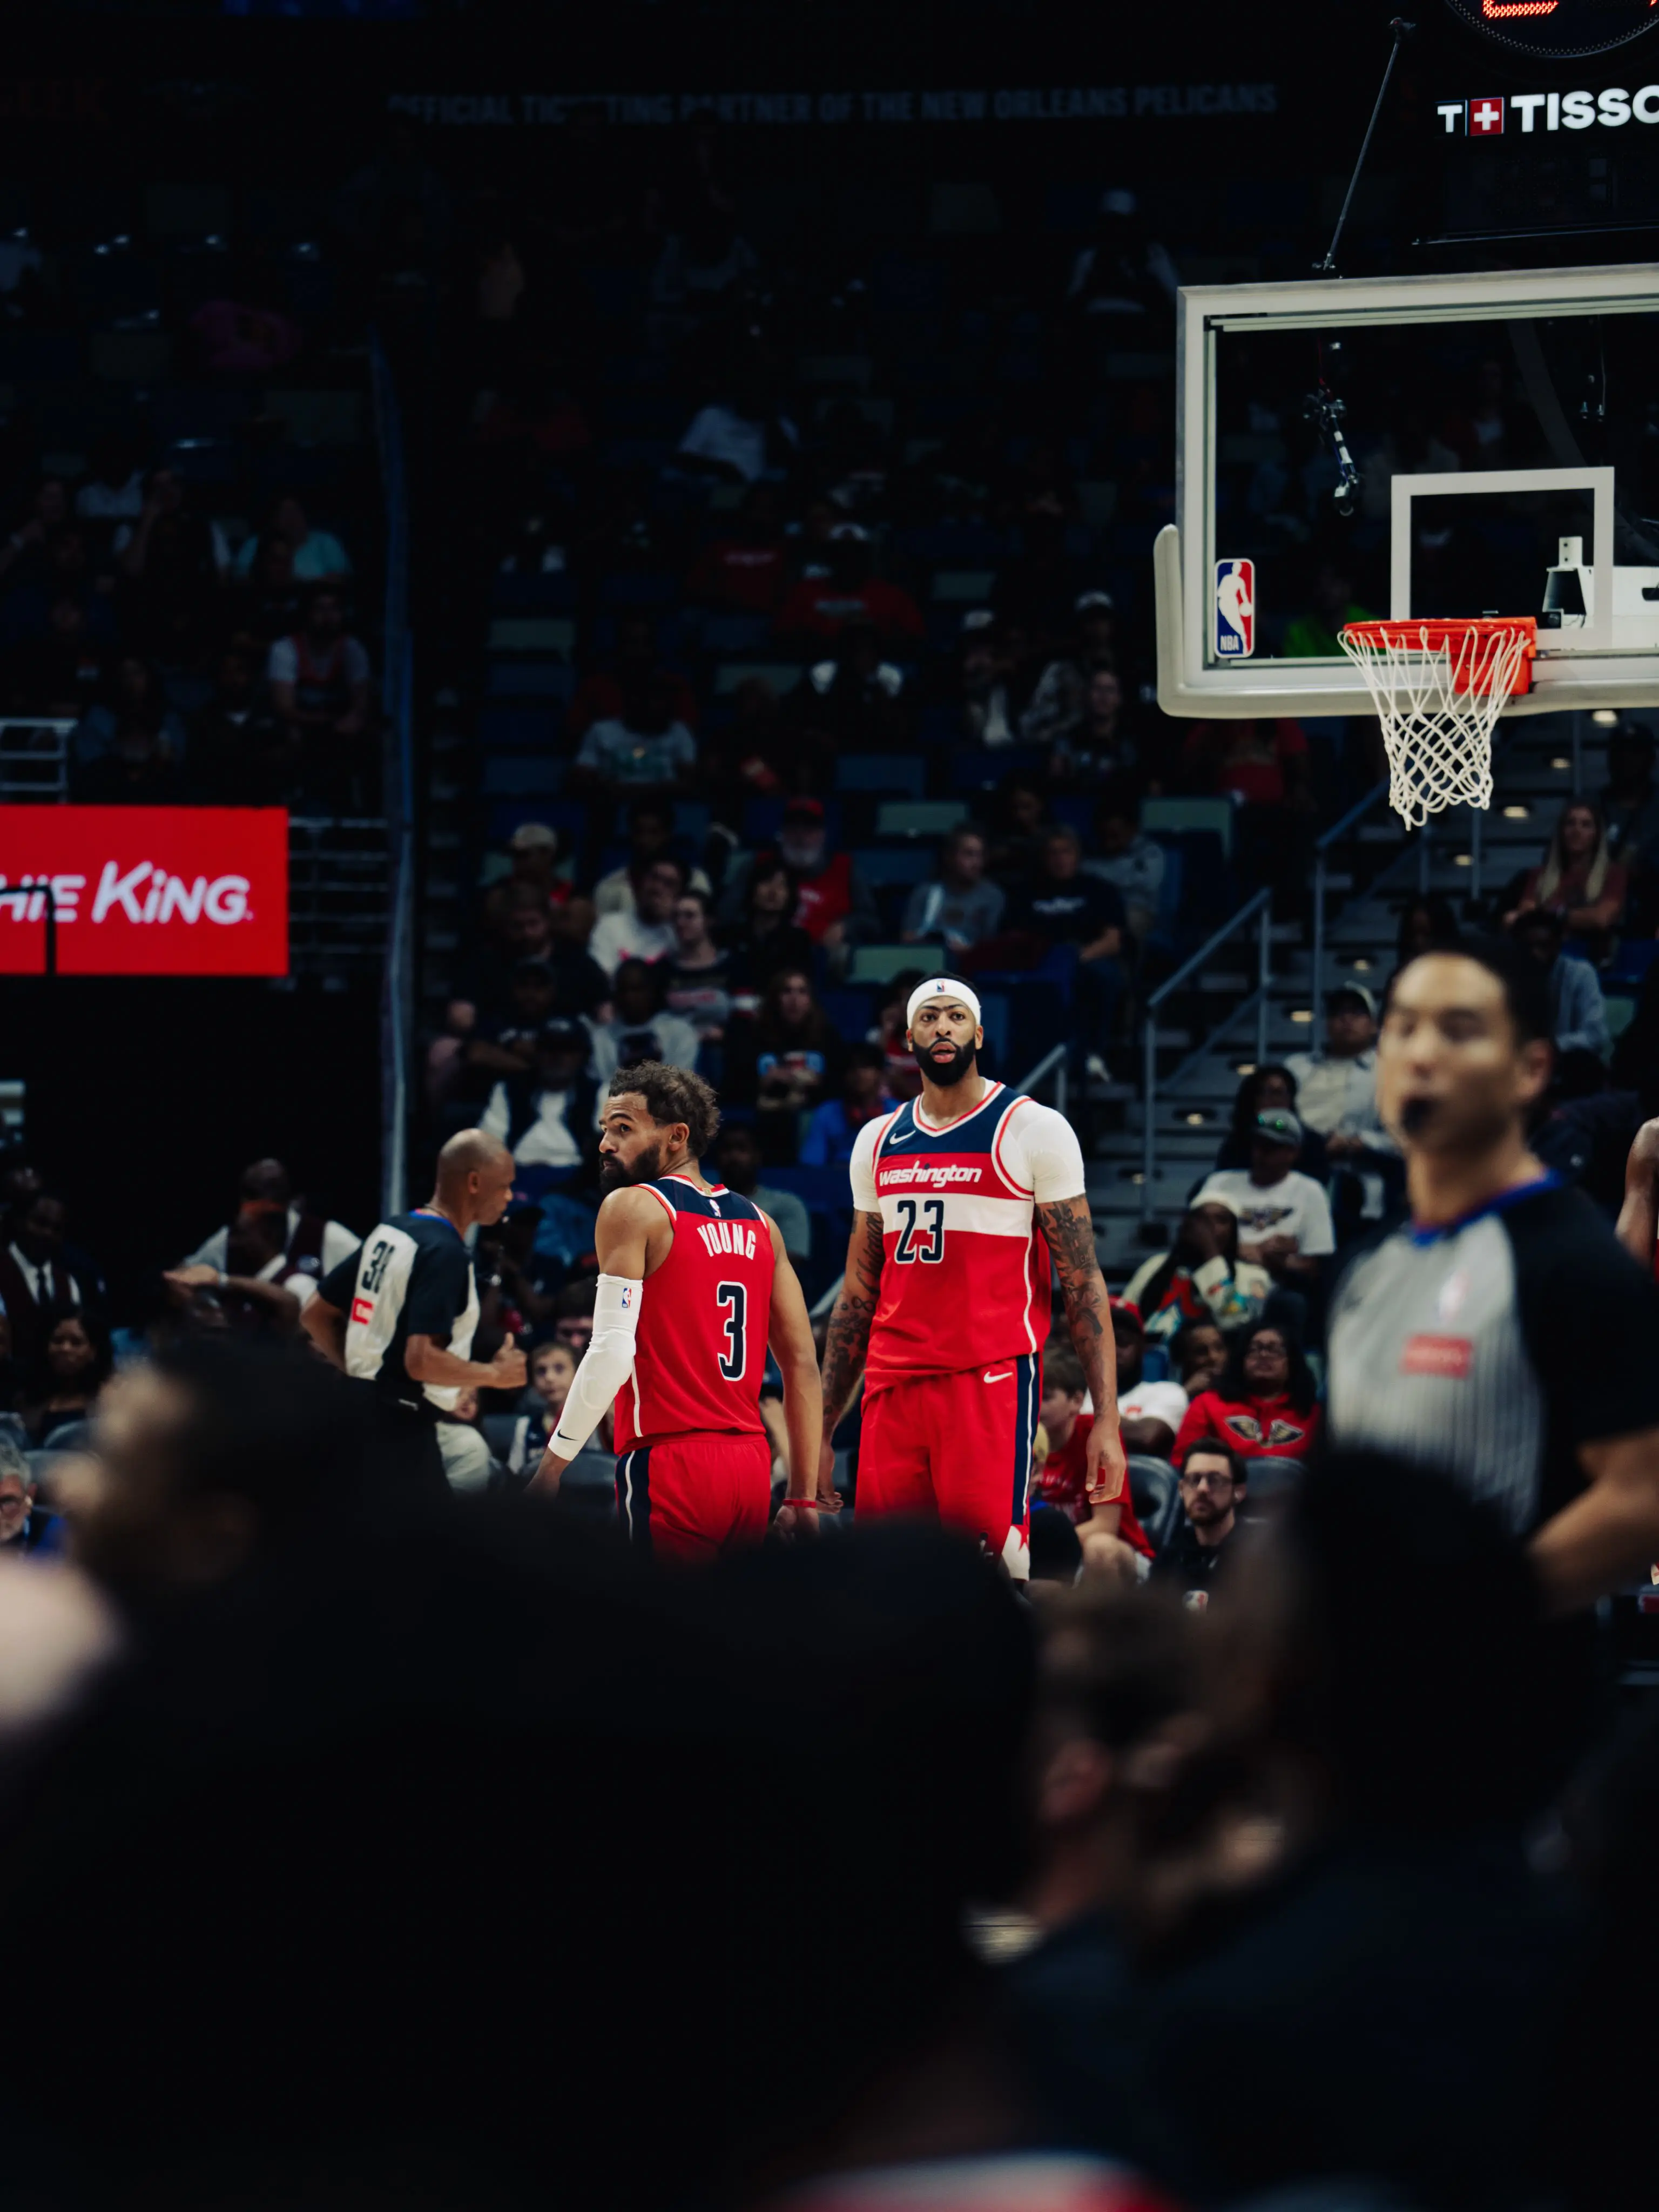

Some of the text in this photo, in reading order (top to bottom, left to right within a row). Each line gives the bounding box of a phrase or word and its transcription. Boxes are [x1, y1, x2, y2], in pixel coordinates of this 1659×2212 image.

[818, 92, 853, 122] OF
[863, 91, 914, 121] THE
[921, 90, 986, 120] NEW
[994, 87, 1128, 118] ORLEANS
[1134, 83, 1278, 116] PELICANS
[1220, 635, 1239, 651] NBA
[879, 1160, 982, 1188] washington
[697, 1222, 756, 1260] YOUNG
[894, 1200, 945, 1264] 23
[716, 1281, 747, 1381] 3
